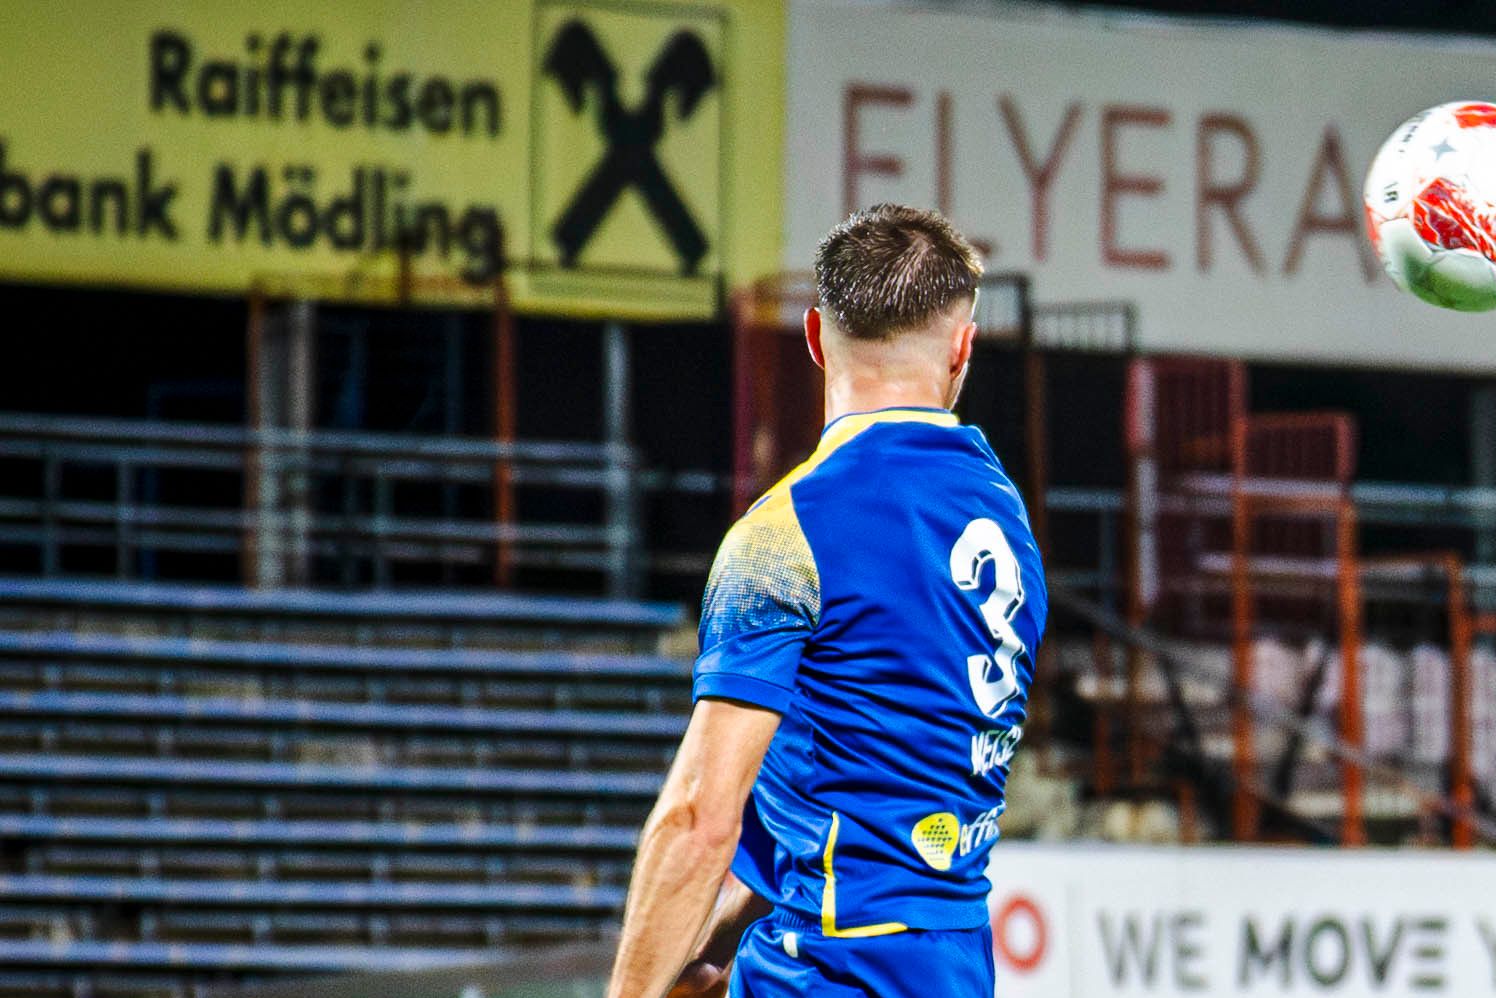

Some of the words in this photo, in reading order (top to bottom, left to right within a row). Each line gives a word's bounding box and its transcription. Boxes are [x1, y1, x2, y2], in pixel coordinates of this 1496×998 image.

[149, 30, 503, 138] Raiffeisen
[0, 136, 180, 242] bank
[207, 160, 507, 285] Mödling
[949, 517, 1026, 719] 3
[1097, 909, 1209, 991] WE
[1236, 912, 1449, 993] MOVE
